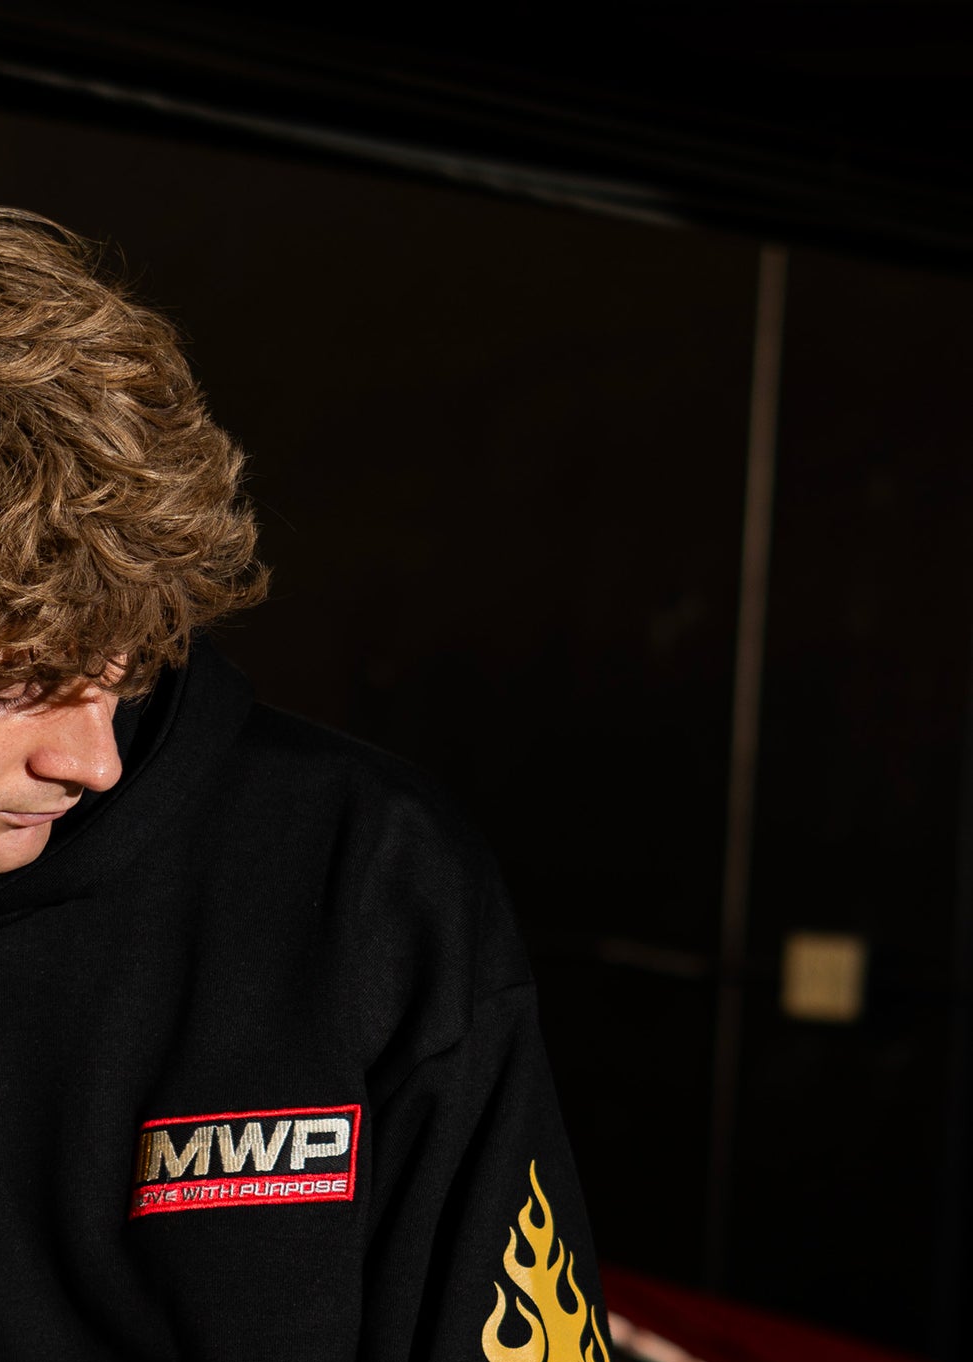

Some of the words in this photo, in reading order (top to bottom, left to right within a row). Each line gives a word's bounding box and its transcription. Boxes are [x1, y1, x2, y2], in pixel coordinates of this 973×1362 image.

[147, 1118, 352, 1182] MWP
[137, 1189, 178, 1208] OVE
[182, 1182, 235, 1202] WITH
[239, 1179, 348, 1197] PURPOSE
